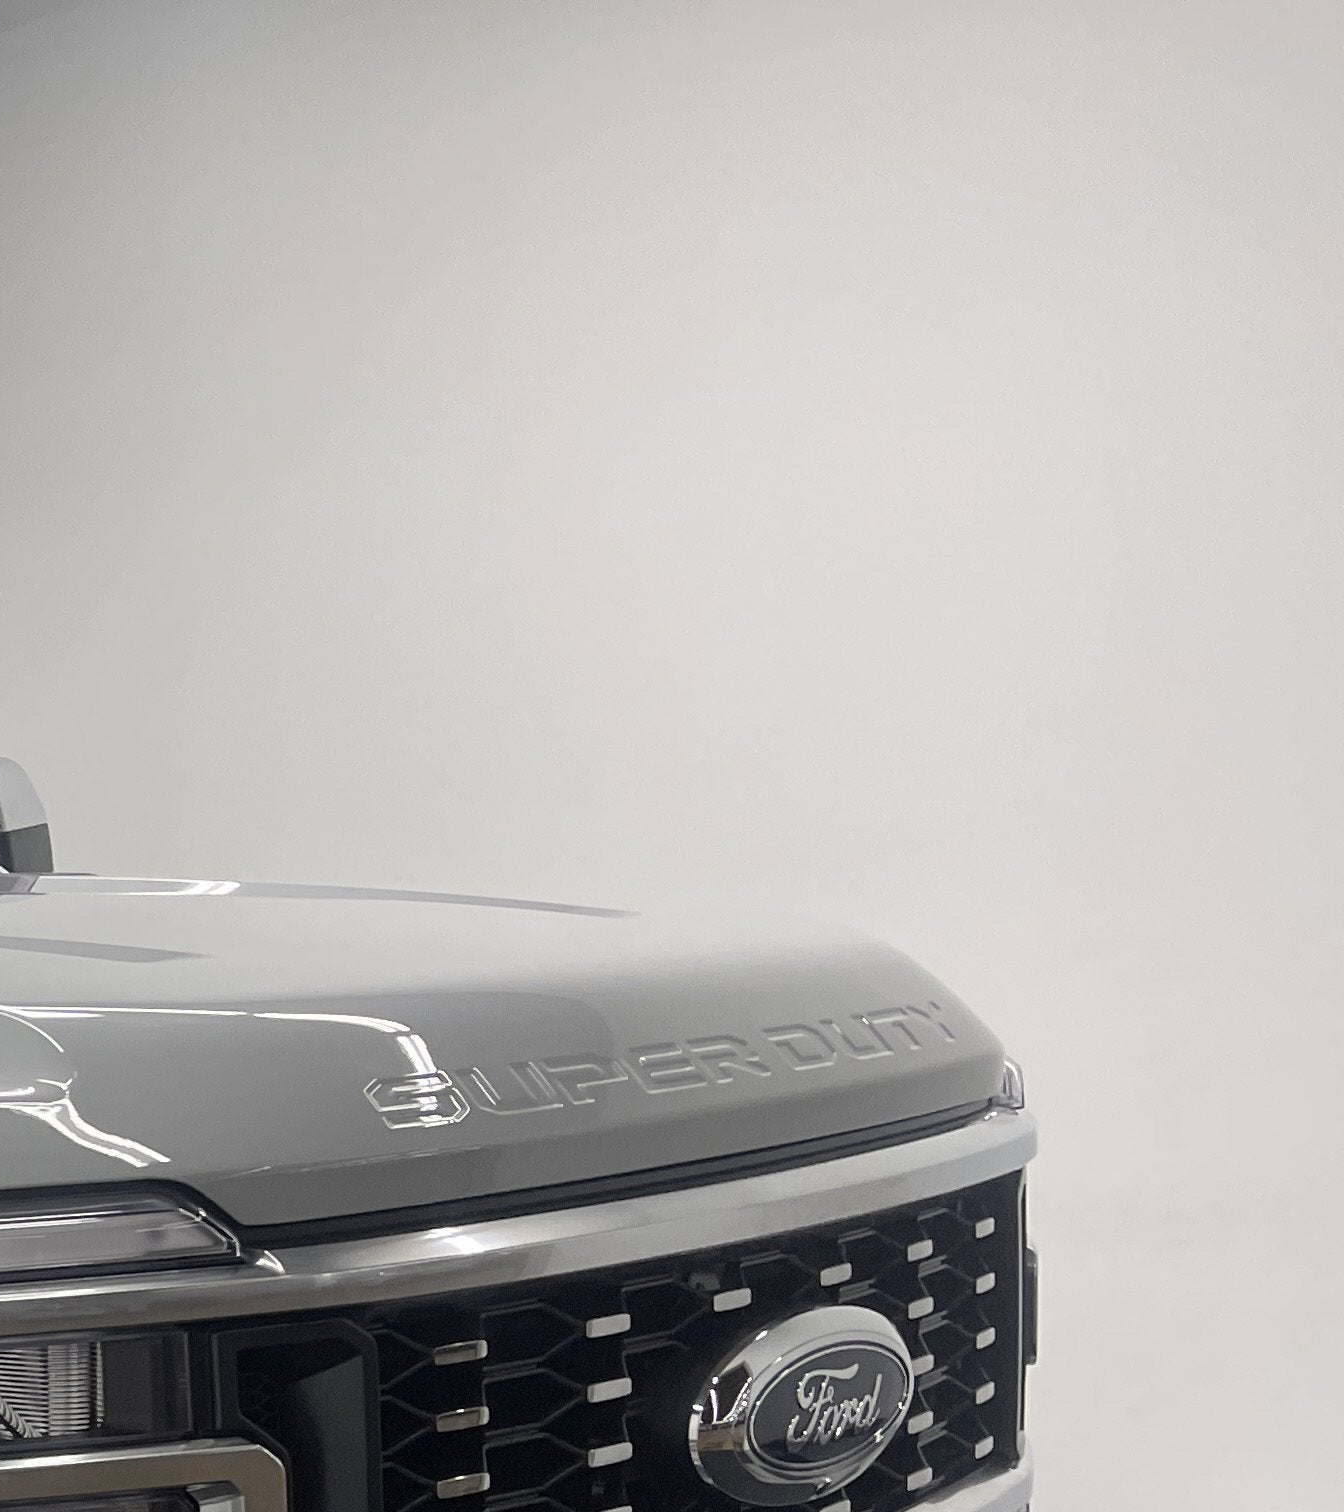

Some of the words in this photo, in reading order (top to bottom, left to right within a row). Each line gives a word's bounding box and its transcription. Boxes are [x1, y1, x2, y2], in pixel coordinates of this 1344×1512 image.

[364, 1034, 772, 1130] SUPER
[767, 1001, 957, 1070] DUTY
[786, 1363, 883, 1453] Ford
